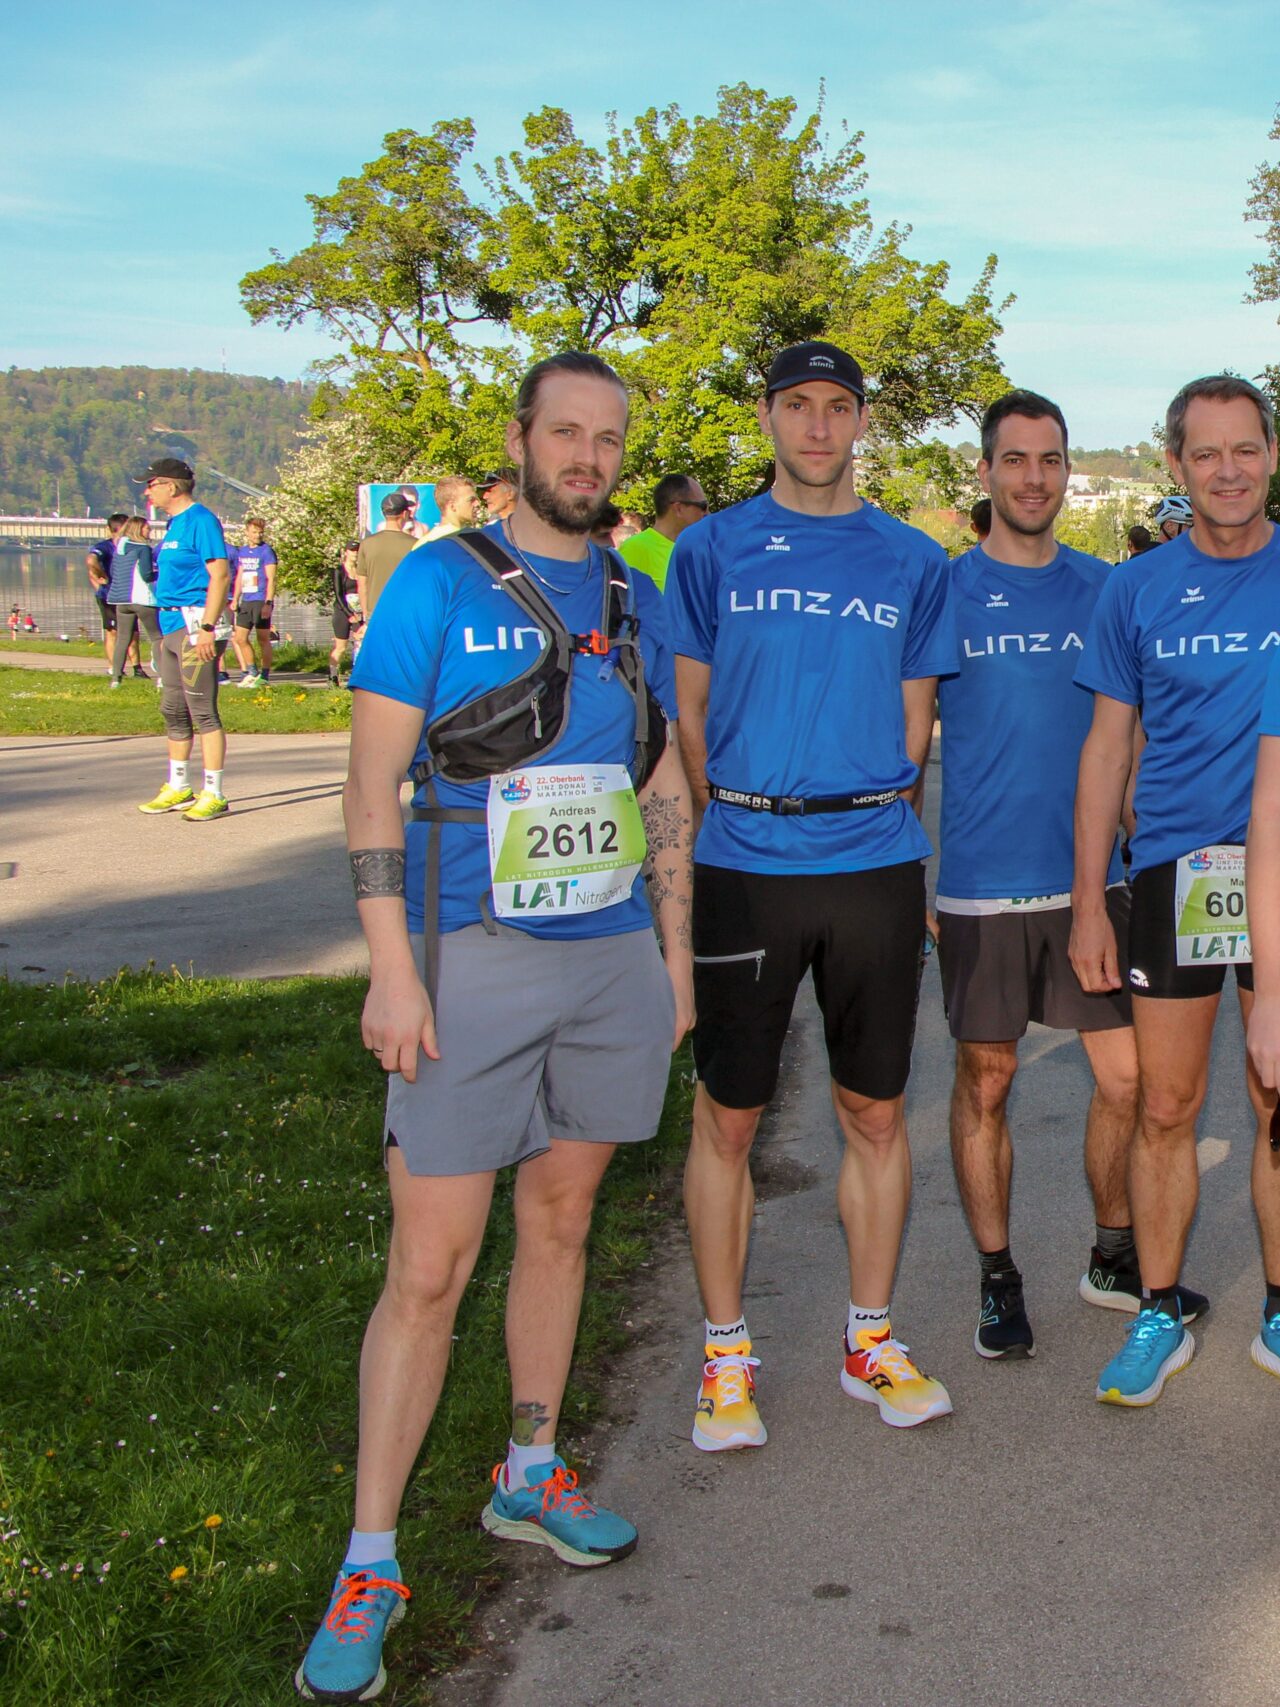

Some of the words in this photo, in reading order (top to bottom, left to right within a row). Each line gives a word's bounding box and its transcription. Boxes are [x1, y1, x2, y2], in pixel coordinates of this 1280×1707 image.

[765, 544, 791, 552] erima
[730, 588, 832, 615] LINZ
[840, 597, 900, 629] AG
[464, 626, 547, 653] LIN
[963, 633, 1052, 658] LINZ
[1060, 632, 1084, 651] A
[1155, 632, 1249, 659] LINZ
[549, 774, 585, 783] Oberbank
[536, 790, 587, 798] MARATHON
[549, 806, 597, 817] Andreas
[527, 820, 619, 859] 2612
[505, 873, 522, 881] LAT
[526, 868, 573, 879] NITROGEN
[1230, 878, 1244, 886] Ma
[512, 880, 570, 909] LAT
[575, 884, 624, 907] Nitrogen
[1205, 891, 1244, 917] 60
[1191, 935, 1240, 959] LAT
